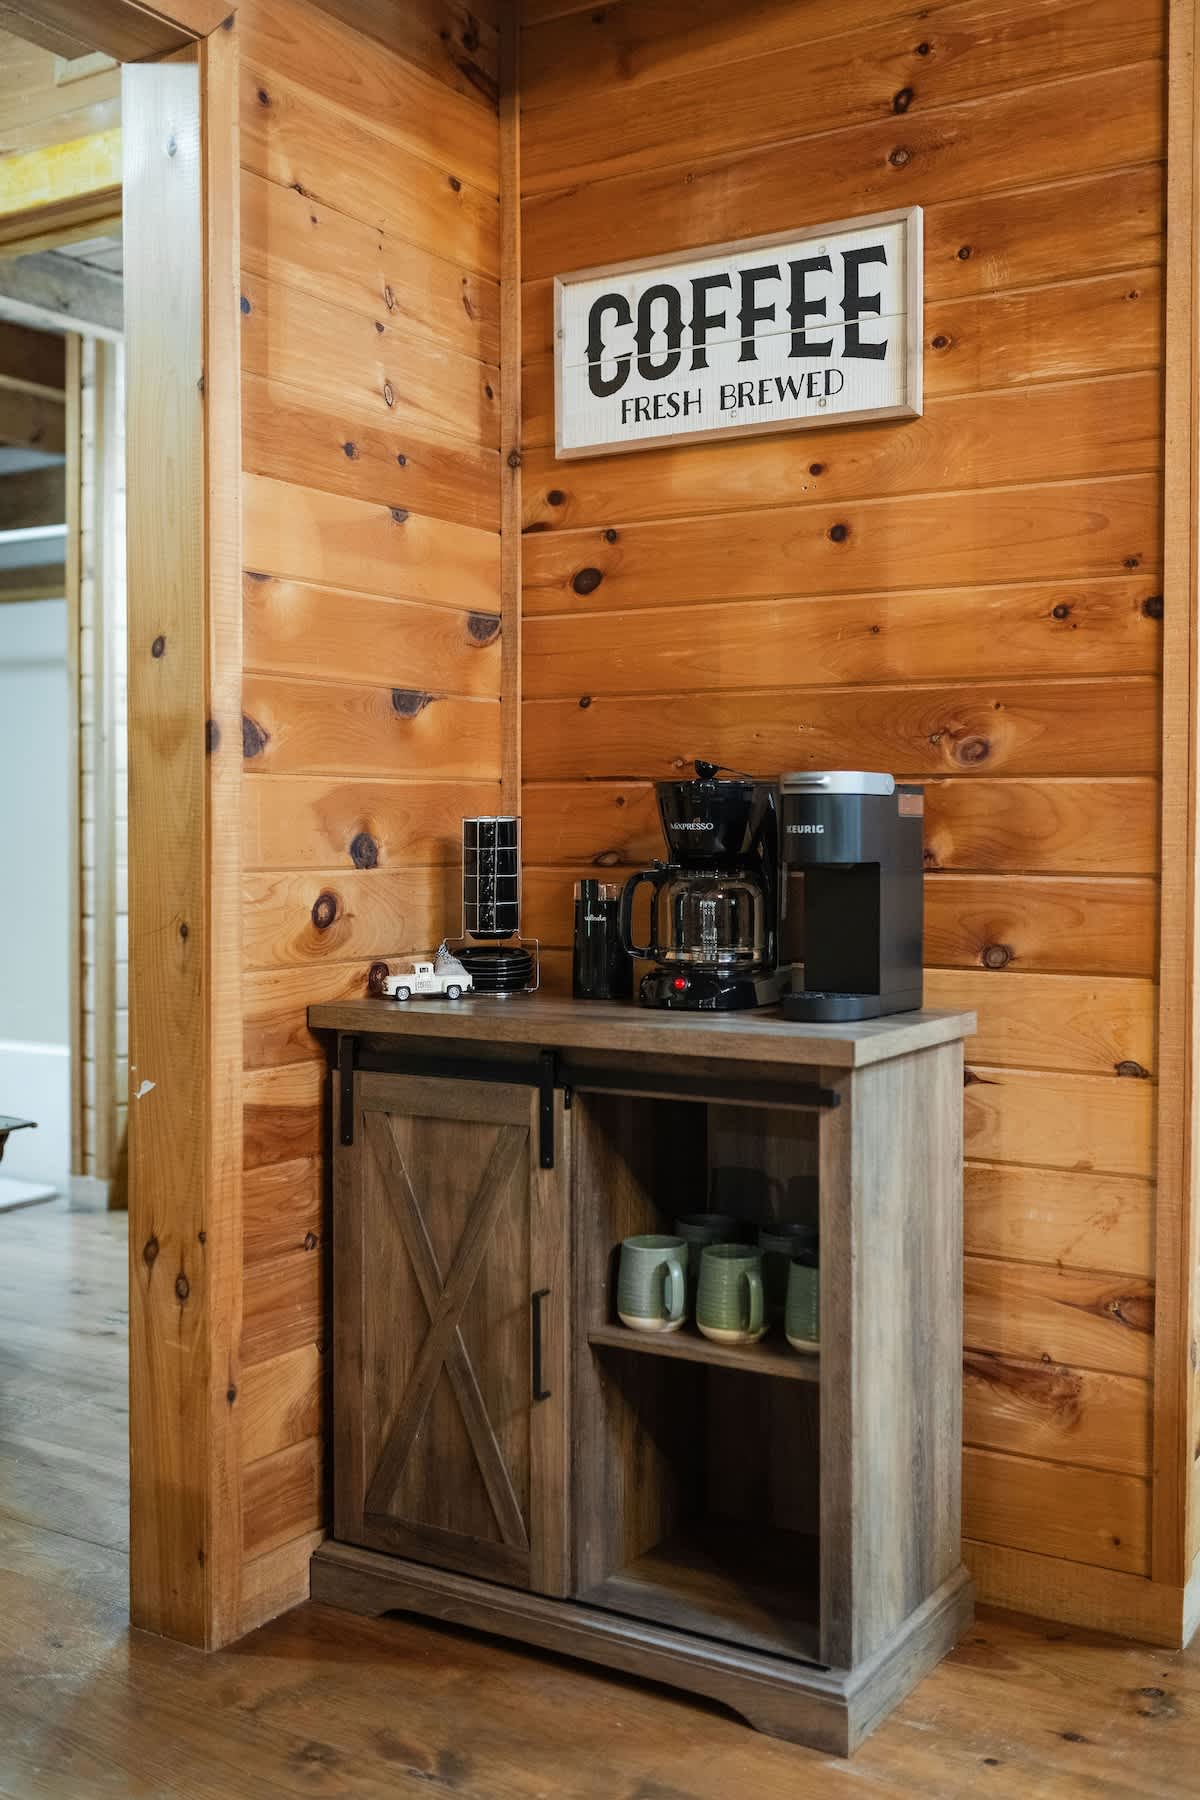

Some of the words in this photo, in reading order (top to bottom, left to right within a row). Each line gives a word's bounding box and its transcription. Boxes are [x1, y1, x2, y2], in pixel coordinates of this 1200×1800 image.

[584, 245, 888, 397] COFFEE
[621, 388, 702, 425] FRESH
[719, 368, 844, 411] BREWED
